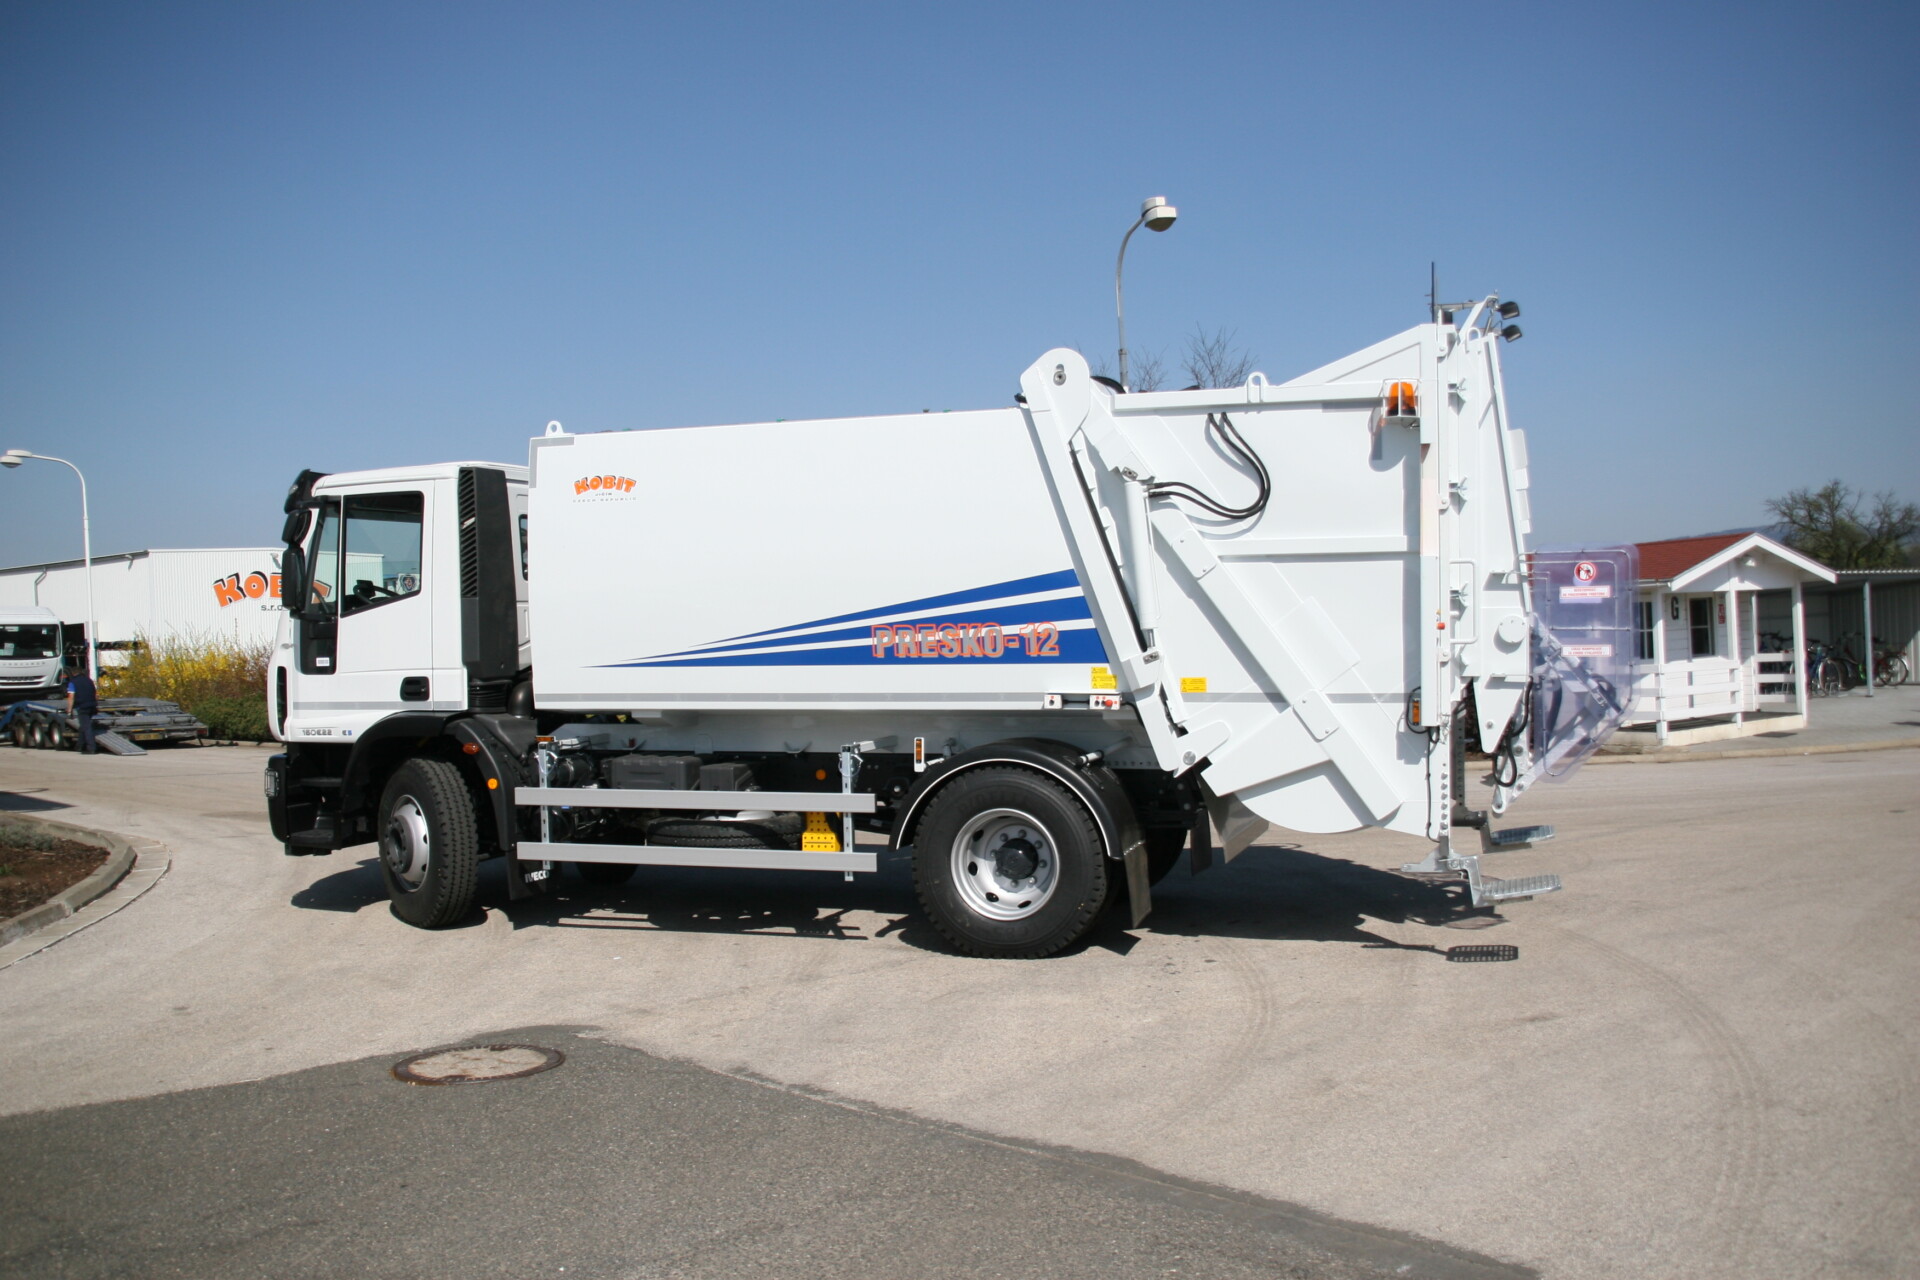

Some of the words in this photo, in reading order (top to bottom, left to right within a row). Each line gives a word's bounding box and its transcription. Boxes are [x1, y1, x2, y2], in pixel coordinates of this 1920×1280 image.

[574, 475, 637, 495] KOBIT
[1671, 596, 1679, 620] G
[871, 622, 1060, 658] PRESKO-12
[524, 870, 550, 883] IVECO
